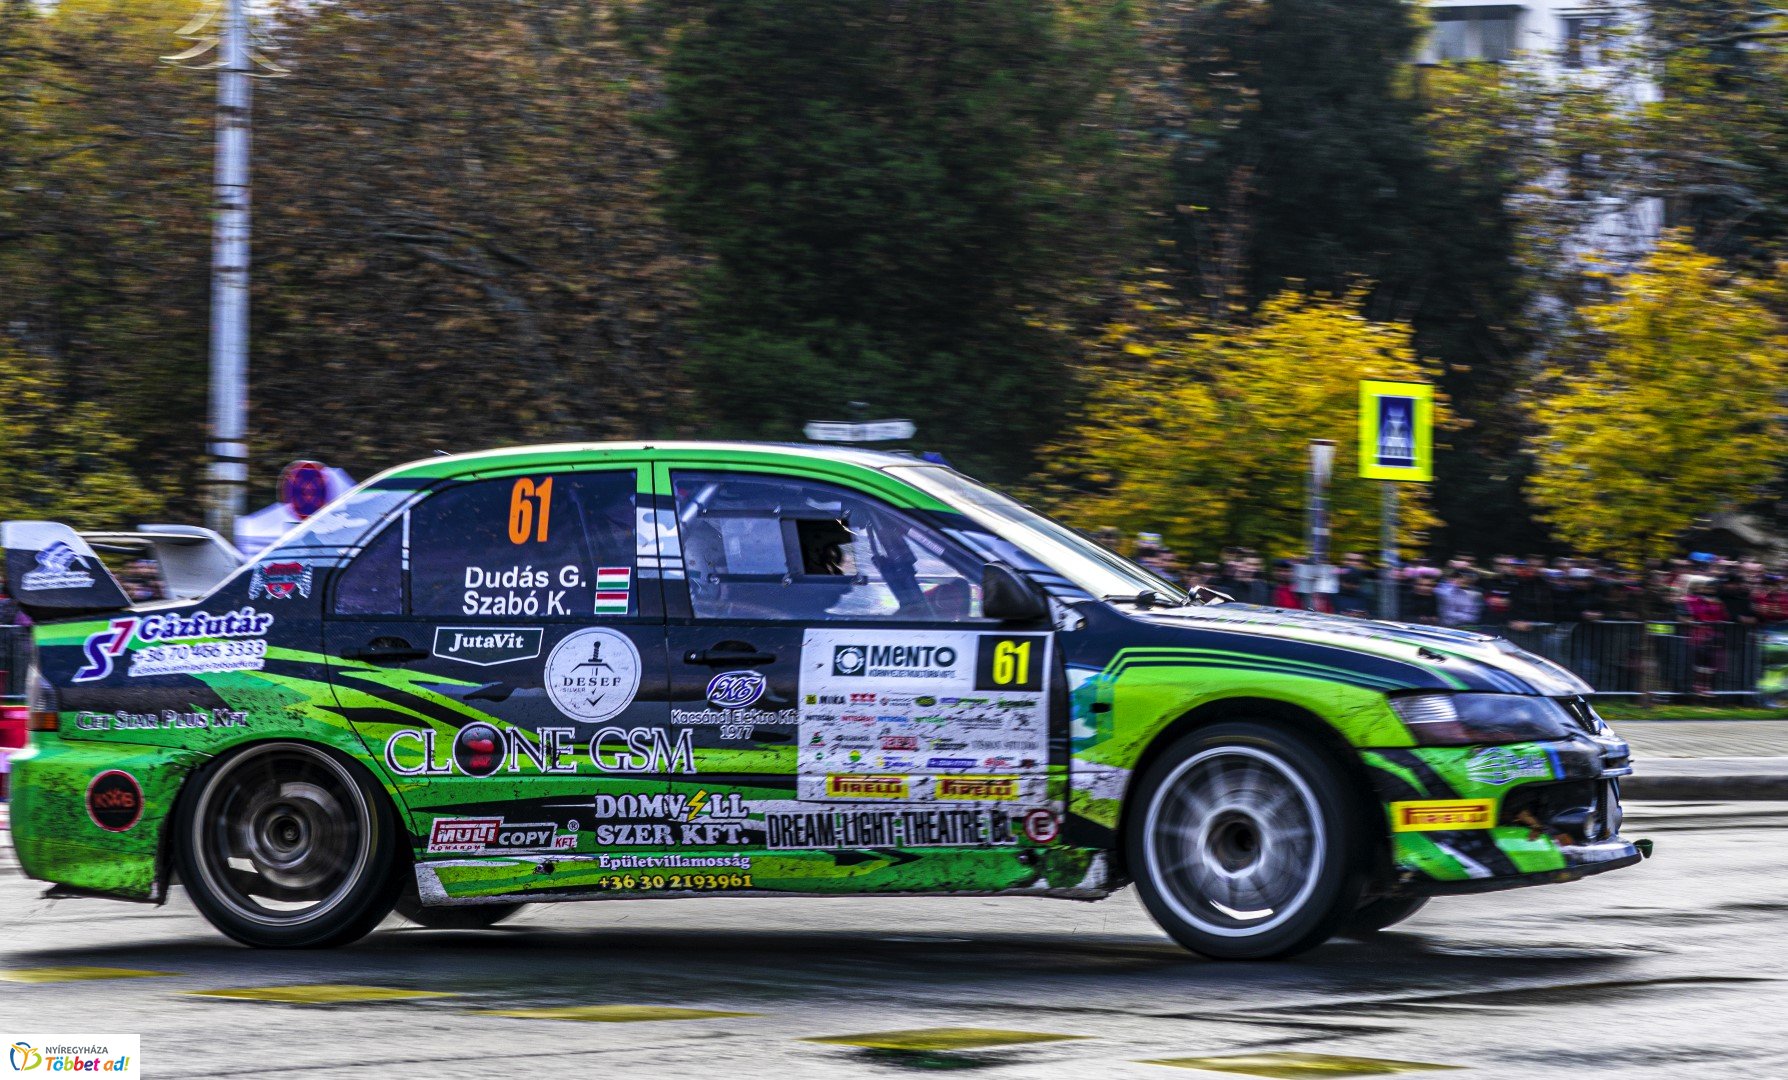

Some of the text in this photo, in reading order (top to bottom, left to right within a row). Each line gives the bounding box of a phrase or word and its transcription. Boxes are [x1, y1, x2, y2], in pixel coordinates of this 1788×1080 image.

[508, 476, 553, 545] 61
[464, 565, 587, 589] Dudás G.
[462, 590, 572, 616] Szabó K.
[138, 608, 271, 641] Gázfutár
[170, 645, 190, 660] 70
[224, 641, 264, 657] 3333
[448, 633, 524, 653] JutaVit
[992, 640, 1031, 685] 61
[563, 677, 621, 687] DESEF
[670, 708, 731, 725] Kacsándi
[720, 724, 755, 740] 1977
[385, 721, 697, 778] CLONE GSM
[832, 776, 903, 794] PIRELLI
[941, 778, 1013, 797] PIRELLI
[1402, 804, 1489, 826] PIRELLI
[436, 823, 551, 846] MULTI COPY
[554, 836, 576, 848] KFT.
[597, 824, 750, 845] SZER KFT.
[598, 853, 751, 870] Épületvillamosság
[599, 873, 753, 890] +36 30 2193961
